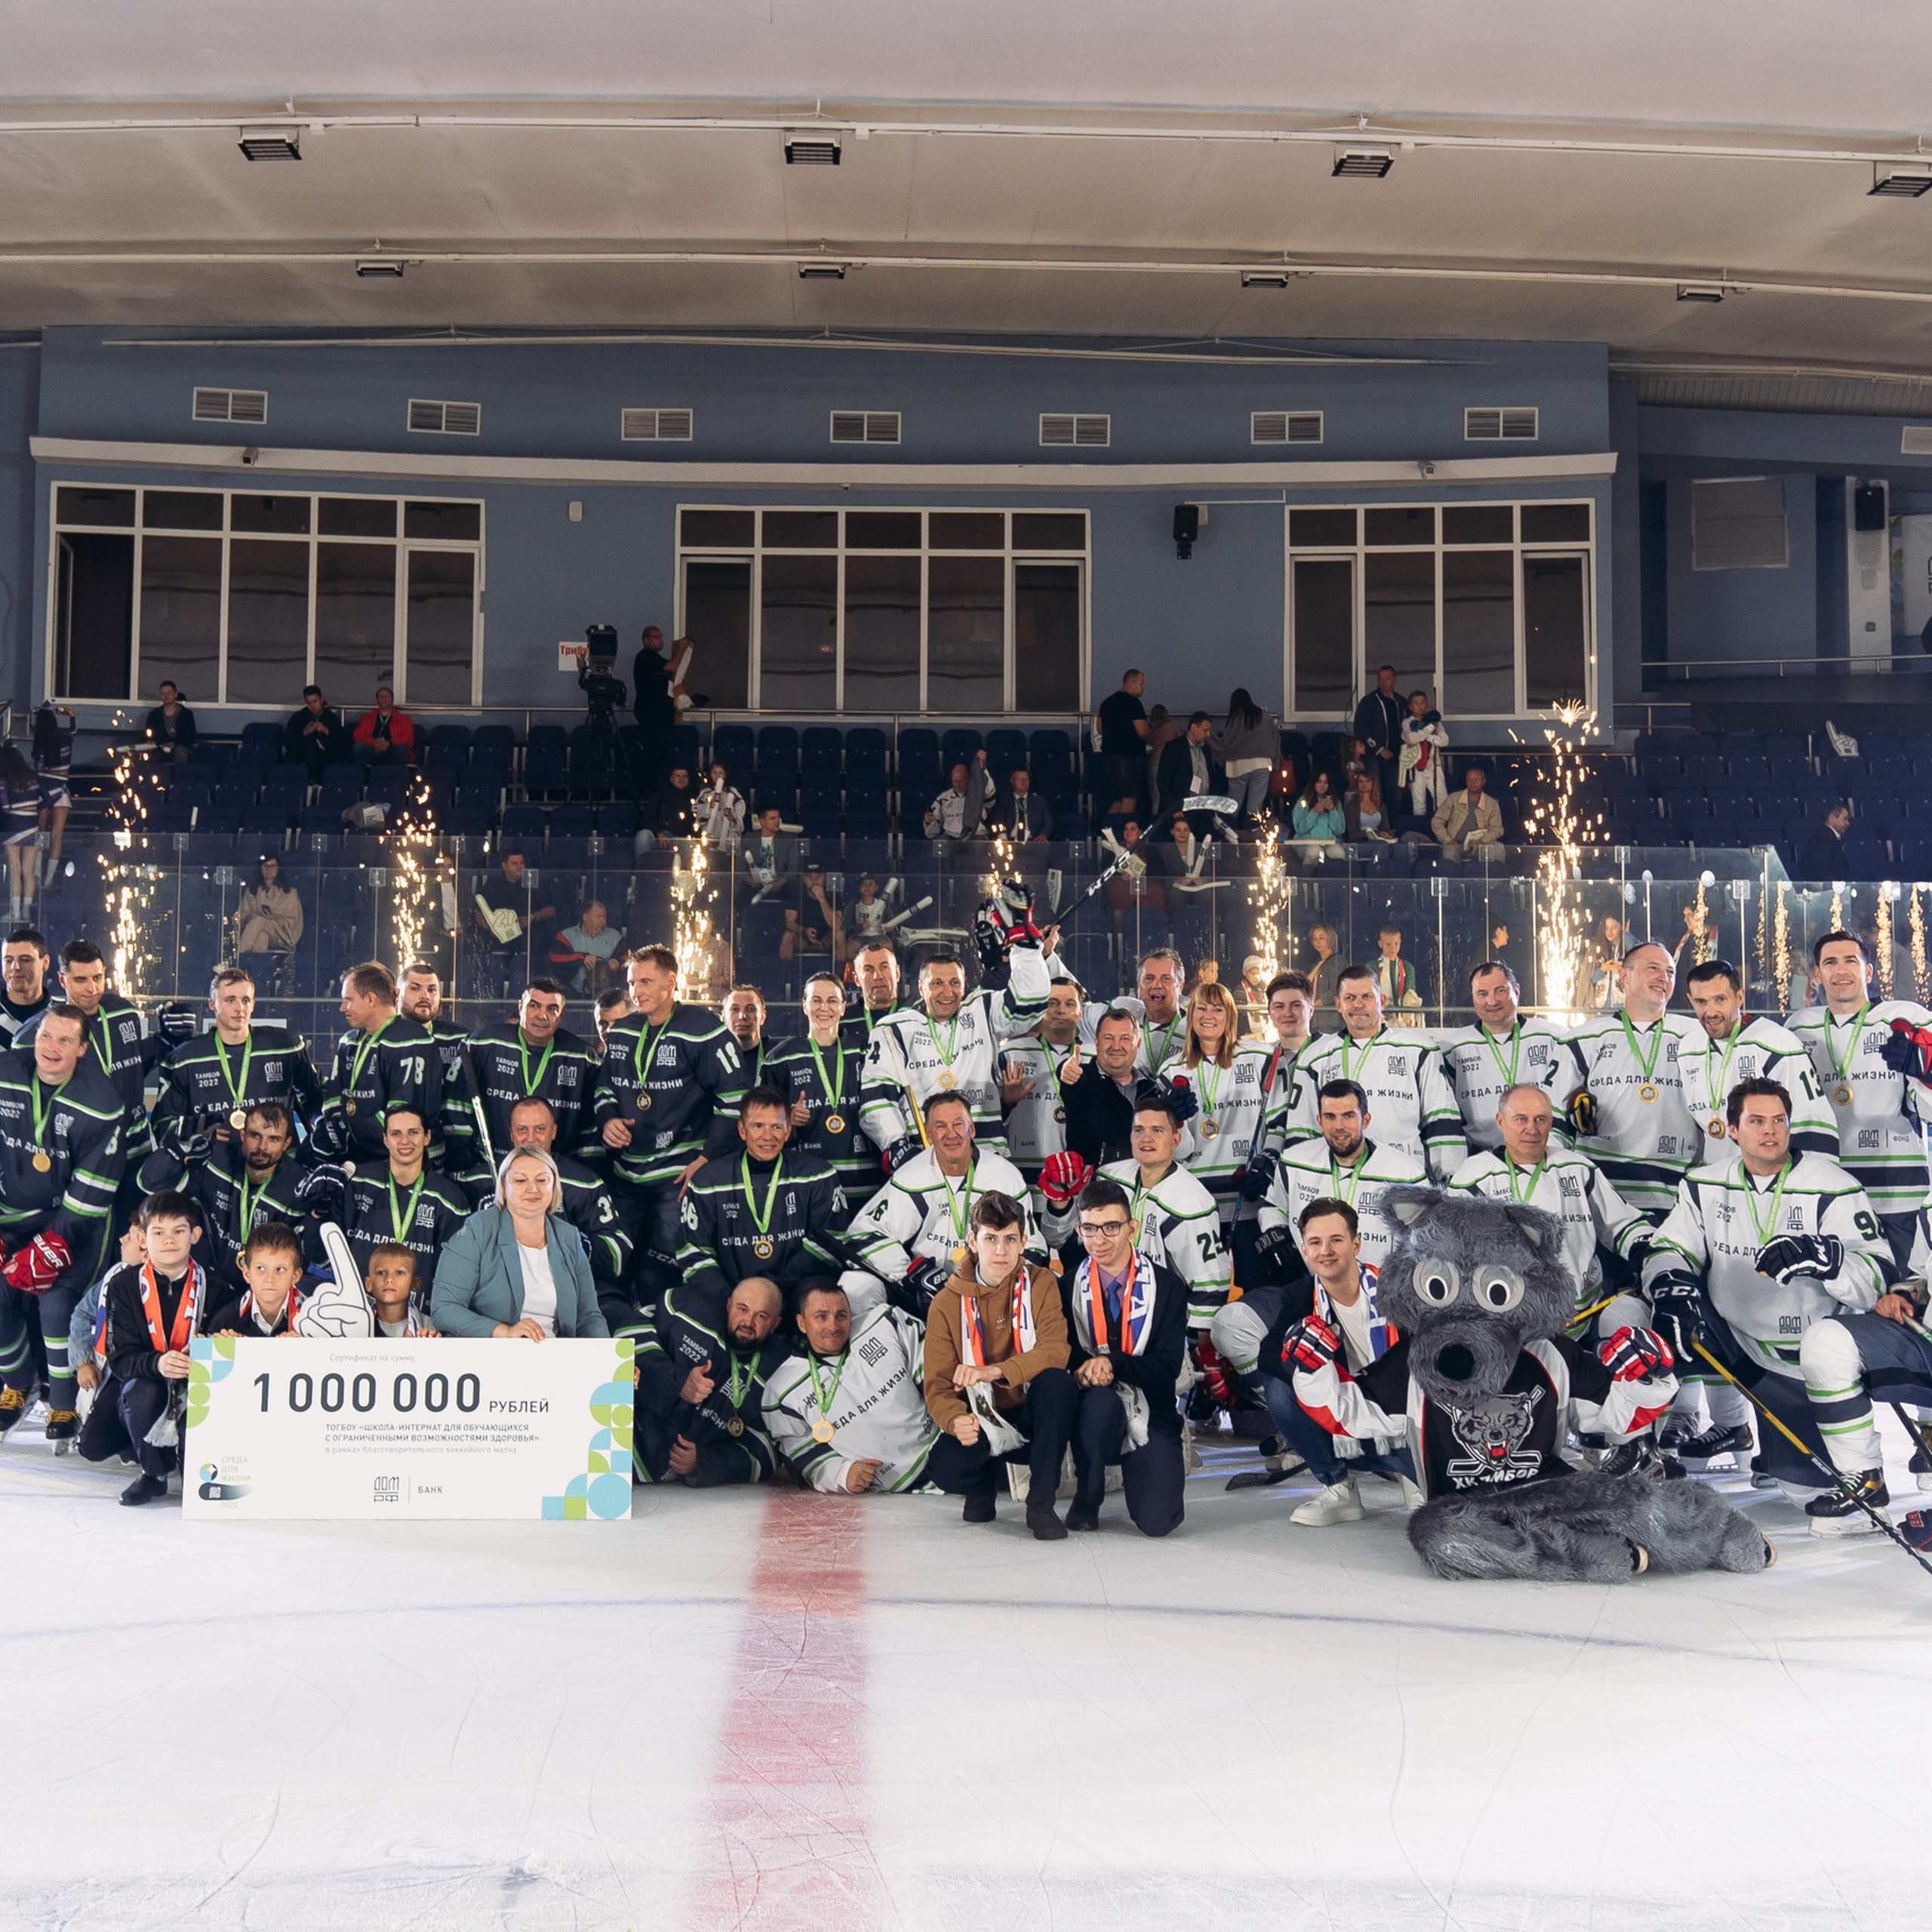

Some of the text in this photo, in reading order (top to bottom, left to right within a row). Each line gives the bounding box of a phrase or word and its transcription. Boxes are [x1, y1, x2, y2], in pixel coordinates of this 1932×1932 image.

[560, 645, 588, 656] Трибу
[915, 1037, 931, 1046] 2022
[868, 1041, 881, 1065] 4
[909, 1060, 943, 1069] СРЕДА
[1457, 1056, 1481, 1065] ТАМБОВ
[400, 1056, 425, 1085] 78
[497, 1066, 515, 1075] 2022
[1462, 1063, 1479, 1072] 2022
[195, 1071, 220, 1079] ТАМБОВ
[1544, 1060, 1559, 1088] 2
[1851, 1072, 1897, 1081] ЖИЗНИ
[198, 1078, 219, 1088] 2022
[649, 1078, 683, 1090] ЖИЗНИ
[1589, 1076, 1621, 1087] СРЕДА
[1626, 1075, 1649, 1084] ДЛЯ
[487, 1088, 519, 1100] СРЕДА
[1378, 1089, 1413, 1100] ЖИЗНИ
[1461, 1084, 1509, 1100] СРЕДА ДЛ
[193, 1103, 229, 1113] СЕДА
[1226, 1098, 1262, 1108] ЖИЗНИ
[1859, 1130, 1879, 1140] ДОМ
[598, 1195, 619, 1223] 3
[1854, 1210, 1884, 1241] 9
[1359, 1232, 1387, 1243] ЗНИ
[1743, 1247, 1758, 1257] ДЛ
[1780, 1315, 1801, 1327] ДОМ
[682, 1334, 709, 1357] ТАМБОВ
[859, 1337, 883, 1360] ДОМ
[329, 1353, 377, 1362] Сертификат
[679, 1344, 702, 1363] 2022
[254, 1373, 549, 1413] 1 000 000 РУБЛЕЙ
[833, 1367, 907, 1430] ЕДА ДЛЯ ЖИЗН
[443, 1424, 461, 1432] ДЛЯ
[463, 1424, 529, 1432] ОБУЧАЮЩИХСЯ
[332, 1447, 360, 1455] рамках
[374, 1476, 399, 1491] ДОМ
[1452, 1476, 1478, 1489] ХК
